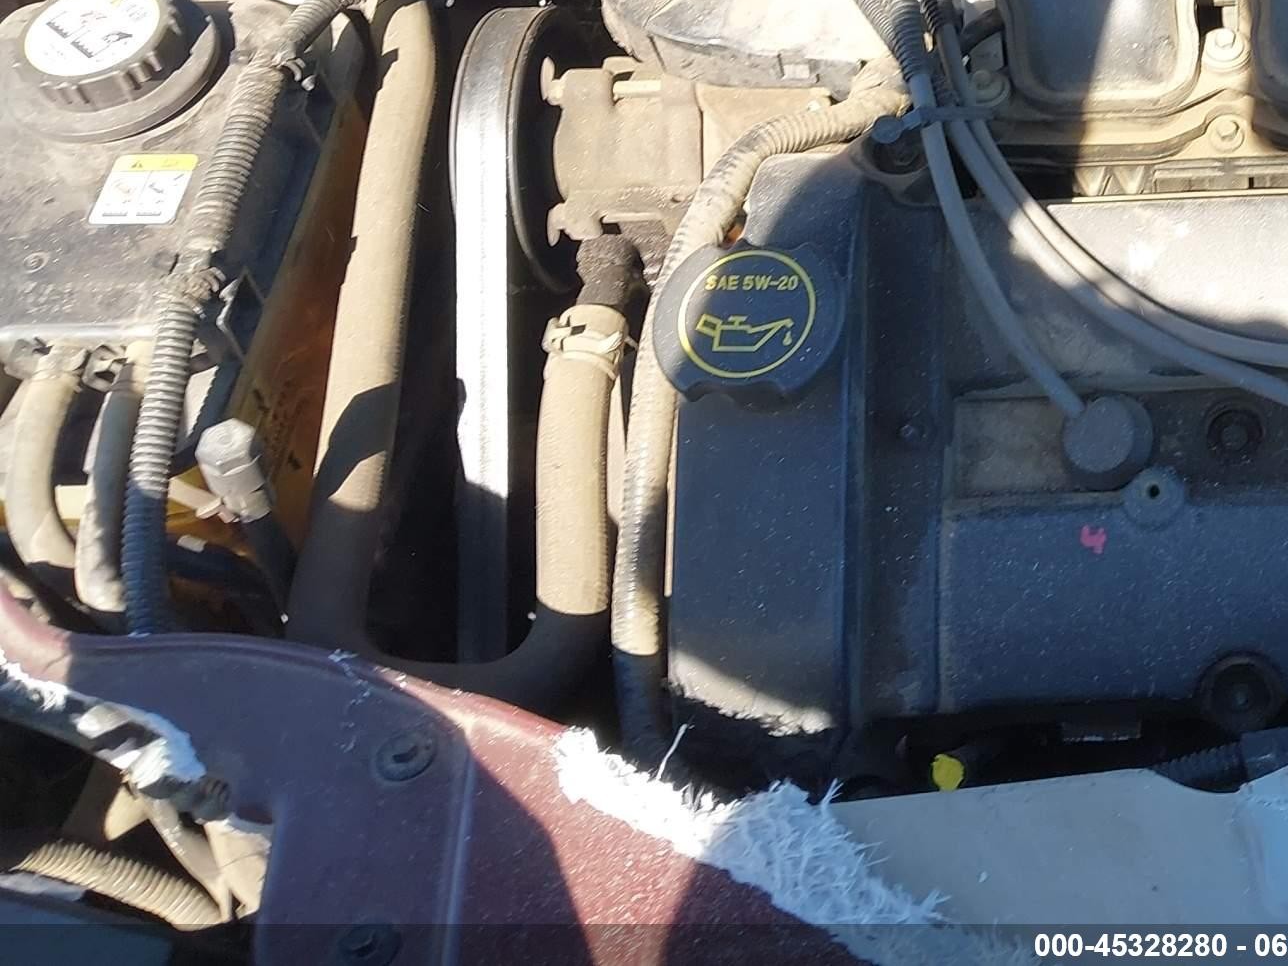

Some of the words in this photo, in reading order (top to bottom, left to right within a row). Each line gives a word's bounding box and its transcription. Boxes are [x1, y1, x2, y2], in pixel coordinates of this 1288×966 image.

[704, 275, 740, 291] SAE
[742, 275, 799, 291] 5W-20
[1080, 524, 1107, 554] 4
